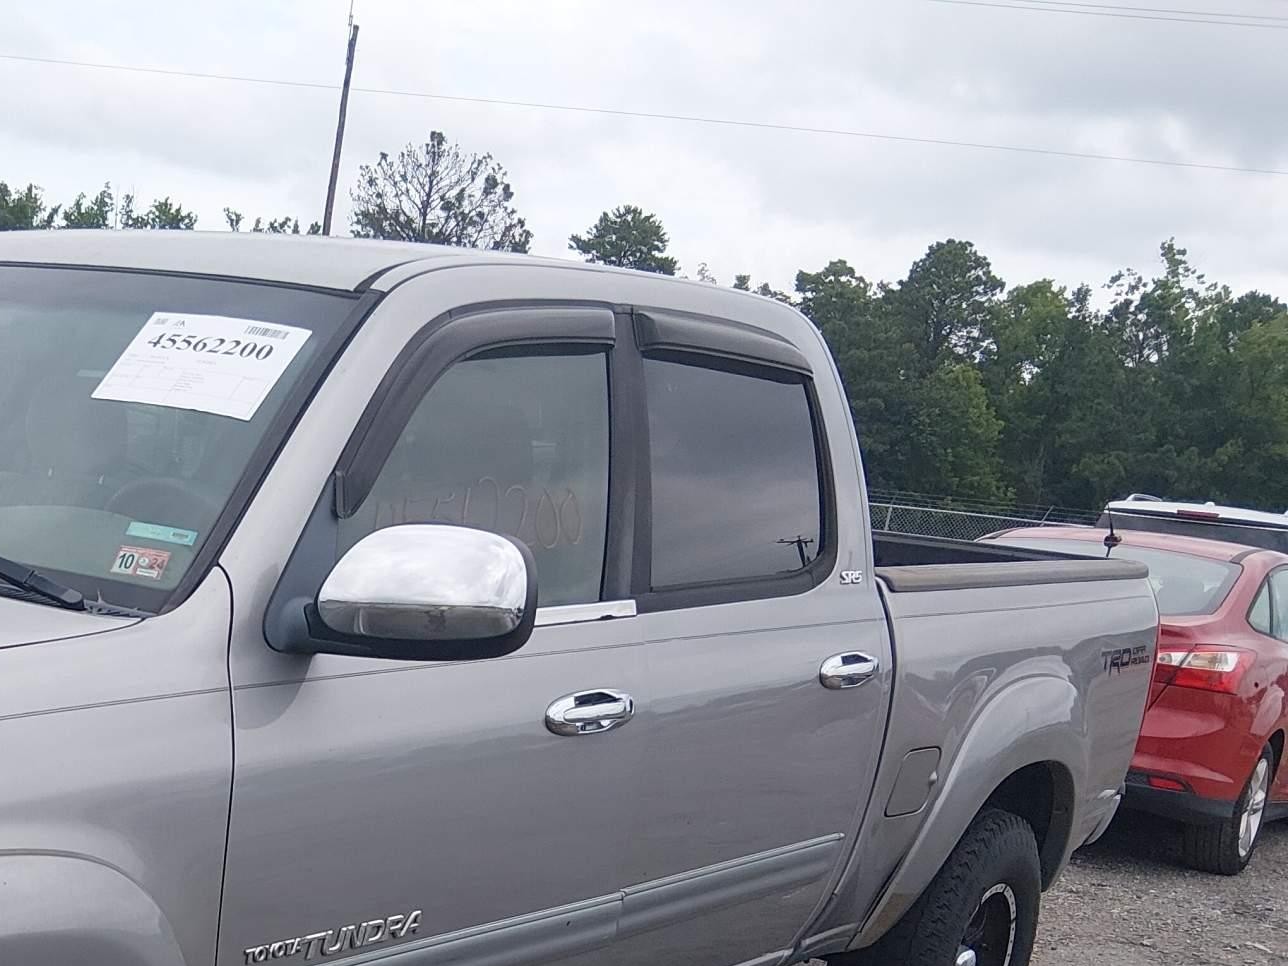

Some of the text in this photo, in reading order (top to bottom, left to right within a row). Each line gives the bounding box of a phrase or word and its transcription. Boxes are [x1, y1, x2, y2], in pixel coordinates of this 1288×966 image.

[147, 333, 274, 361] 45562200
[118, 552, 135, 569] 10
[840, 570, 863, 584] SR5
[1101, 648, 1131, 678] TRD
[244, 910, 422, 965] TOYOTA TUNDRA
